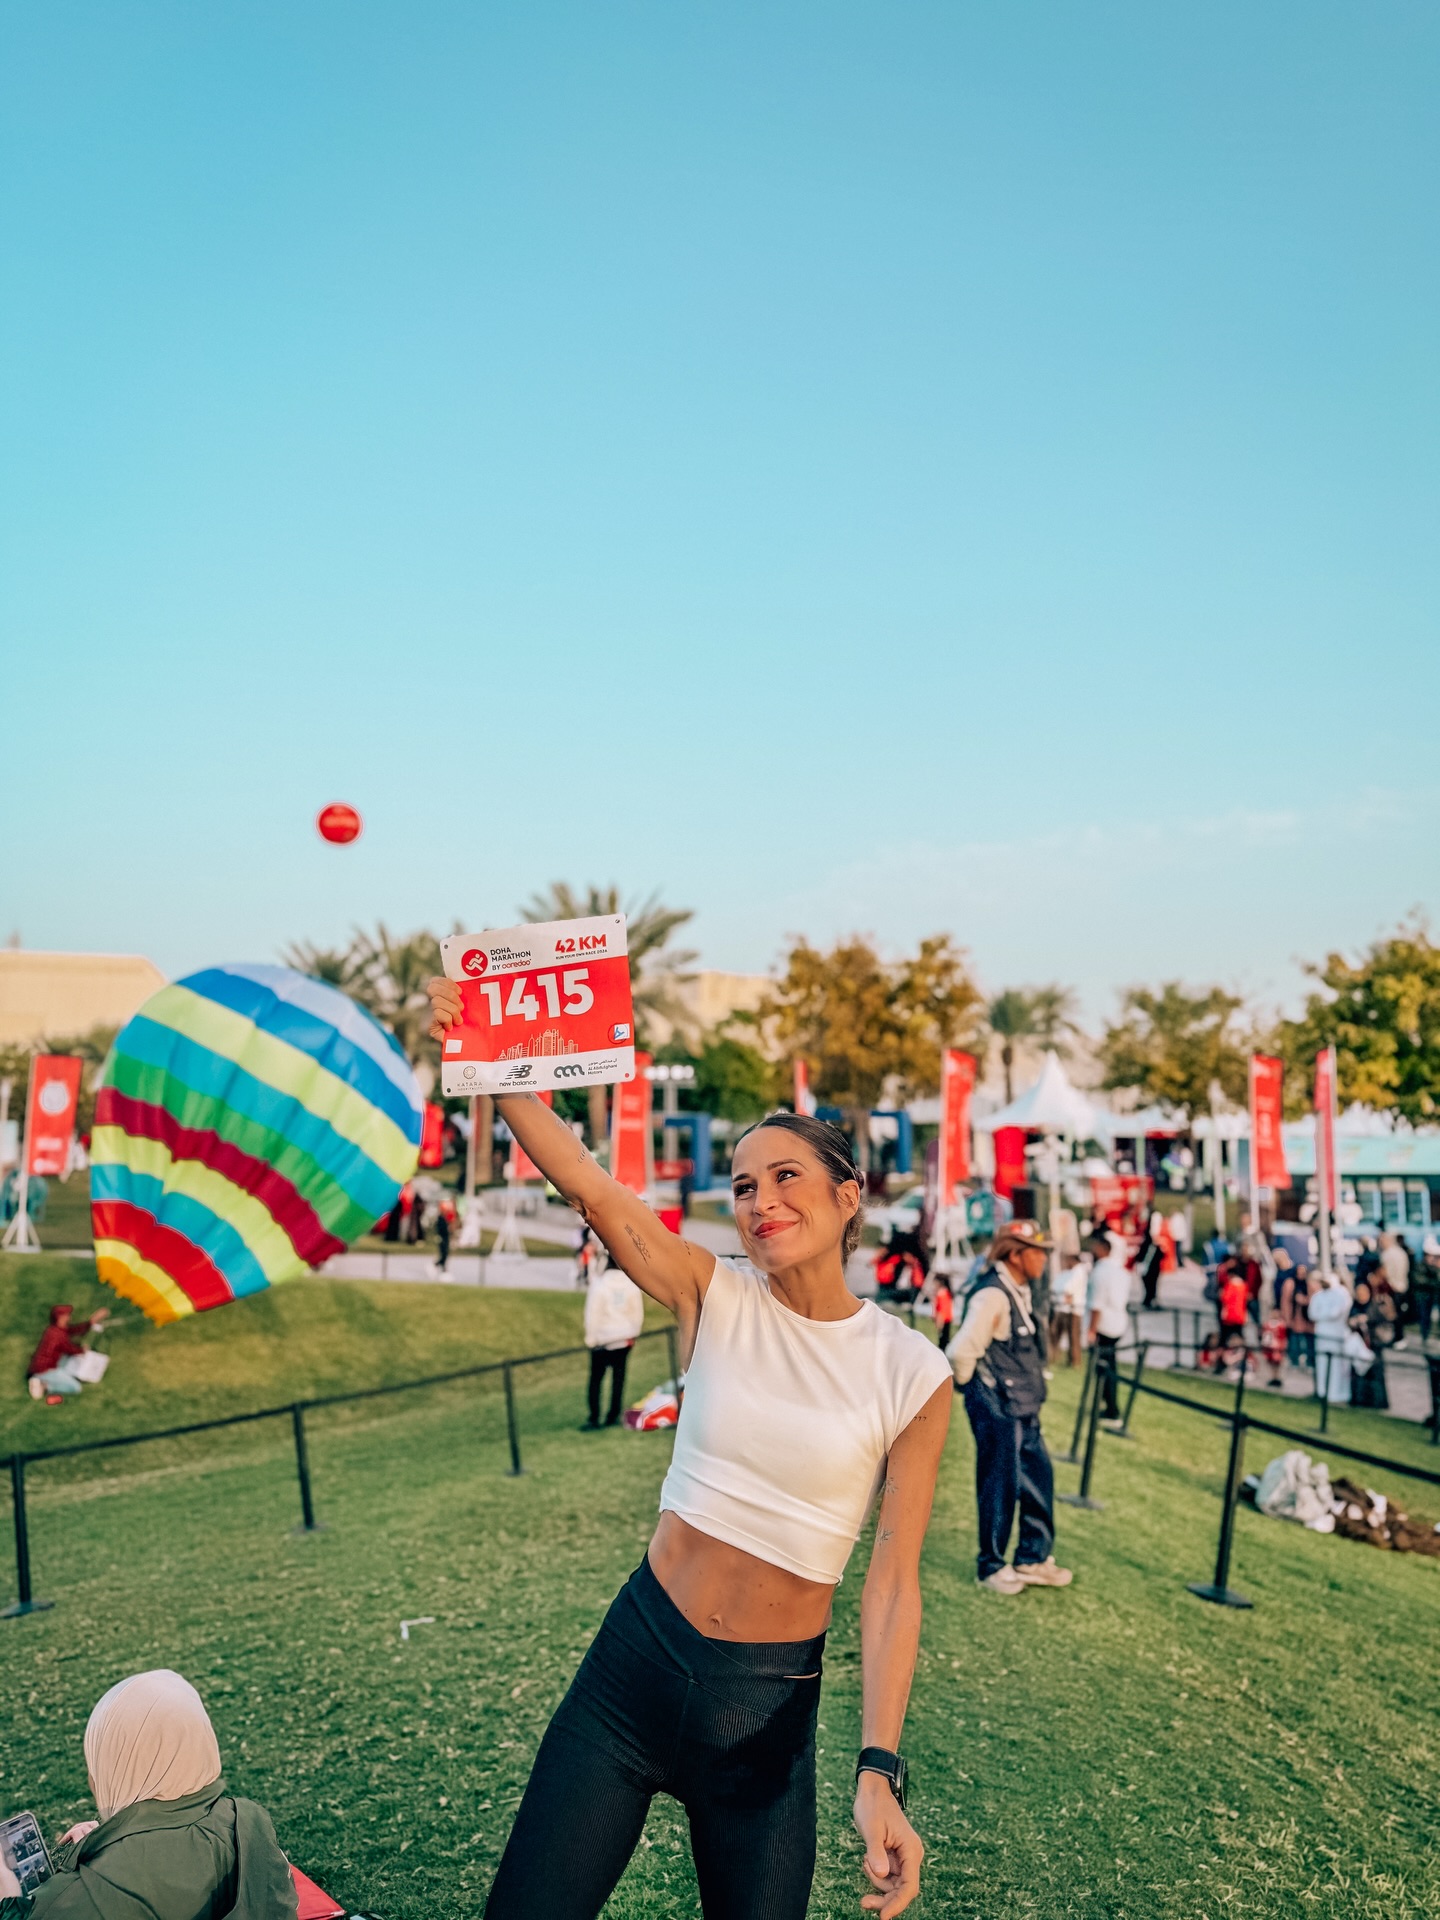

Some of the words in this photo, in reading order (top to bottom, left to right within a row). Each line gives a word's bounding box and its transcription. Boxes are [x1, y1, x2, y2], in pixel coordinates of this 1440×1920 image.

[555, 938, 576, 953] 42
[579, 934, 607, 950] KM
[490, 947, 511, 955] DOHA
[491, 950, 531, 962] MARATHON
[501, 959, 532, 970] ooredoo
[479, 967, 595, 1026] 1415
